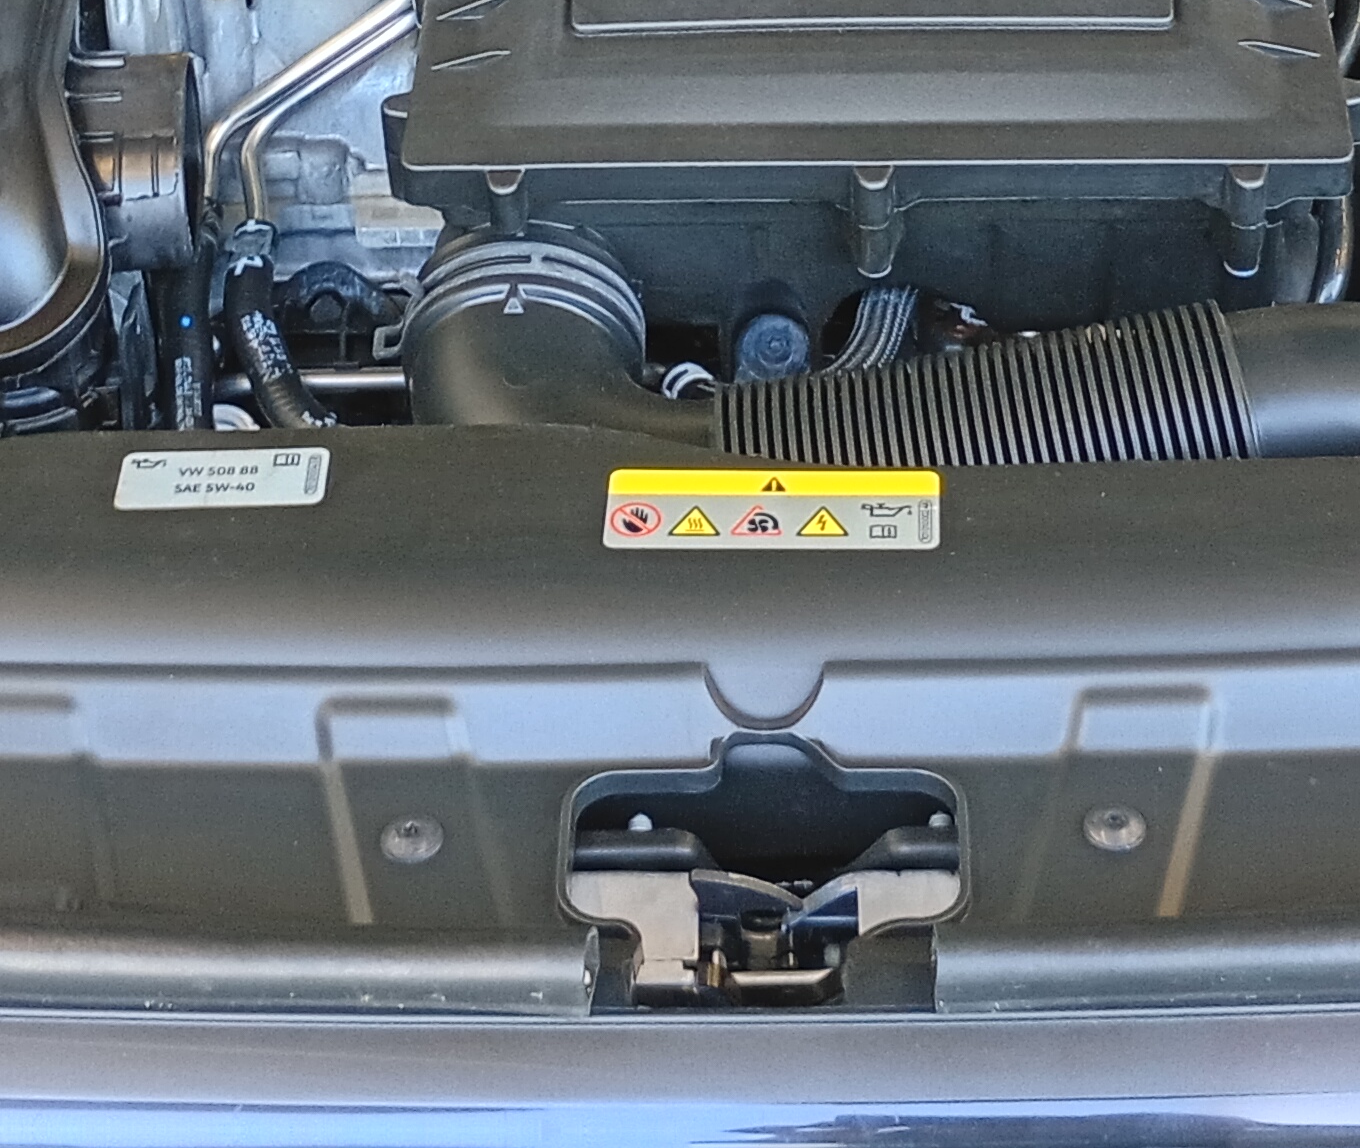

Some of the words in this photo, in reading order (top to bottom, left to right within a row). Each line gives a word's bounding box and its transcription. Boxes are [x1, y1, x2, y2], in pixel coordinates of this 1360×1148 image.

[178, 465, 204, 477] VW
[207, 465, 236, 476] 508
[239, 464, 259, 475] 88
[174, 483, 201, 494] SAE
[205, 481, 256, 494] 5W-40
